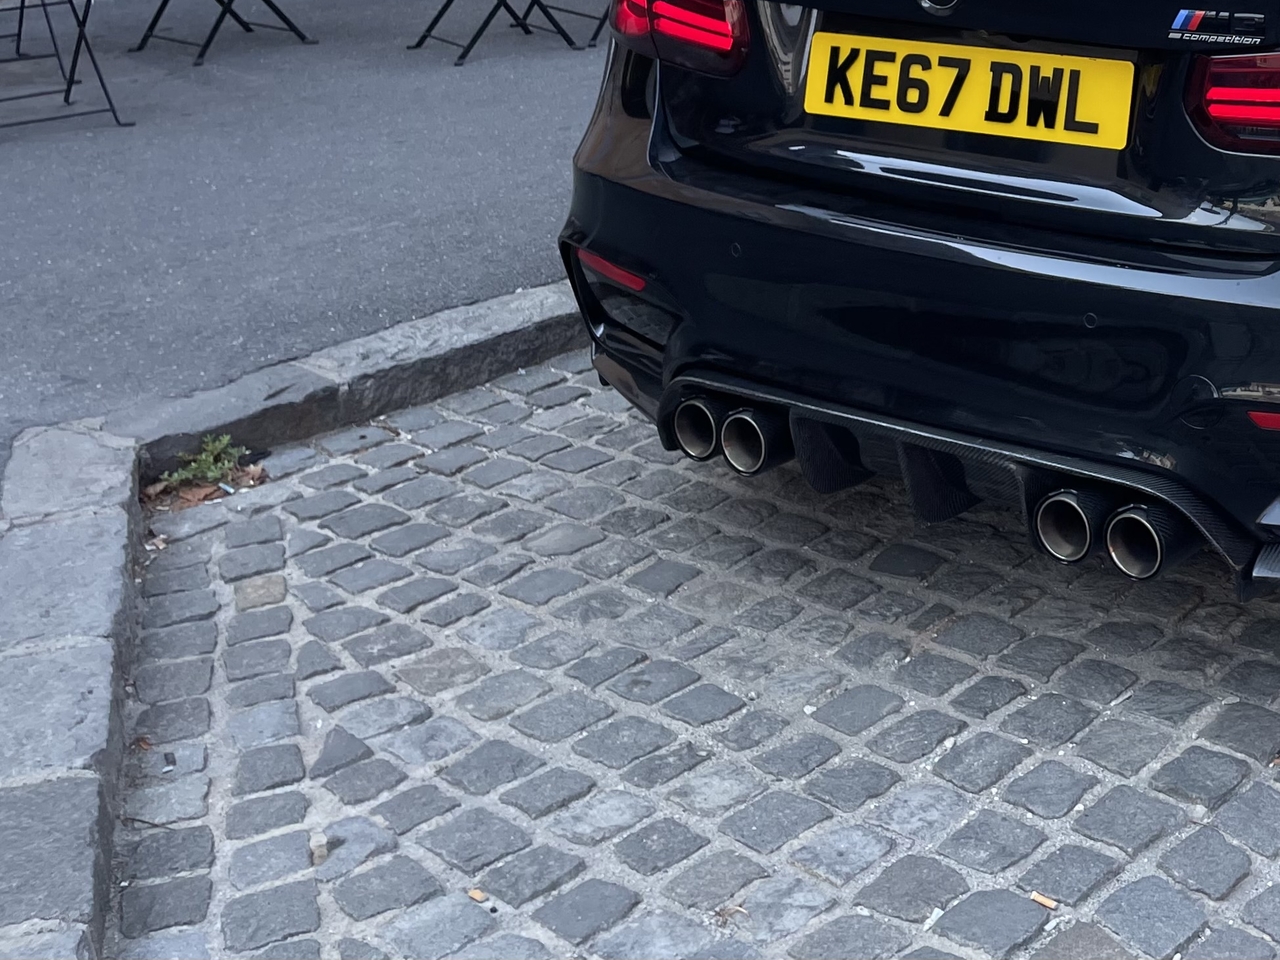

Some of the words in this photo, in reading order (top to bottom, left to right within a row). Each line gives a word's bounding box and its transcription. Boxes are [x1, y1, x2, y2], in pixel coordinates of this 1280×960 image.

[1183, 32, 1260, 44] competition
[824, 46, 971, 117] KE67
[984, 60, 1099, 134] DWL
